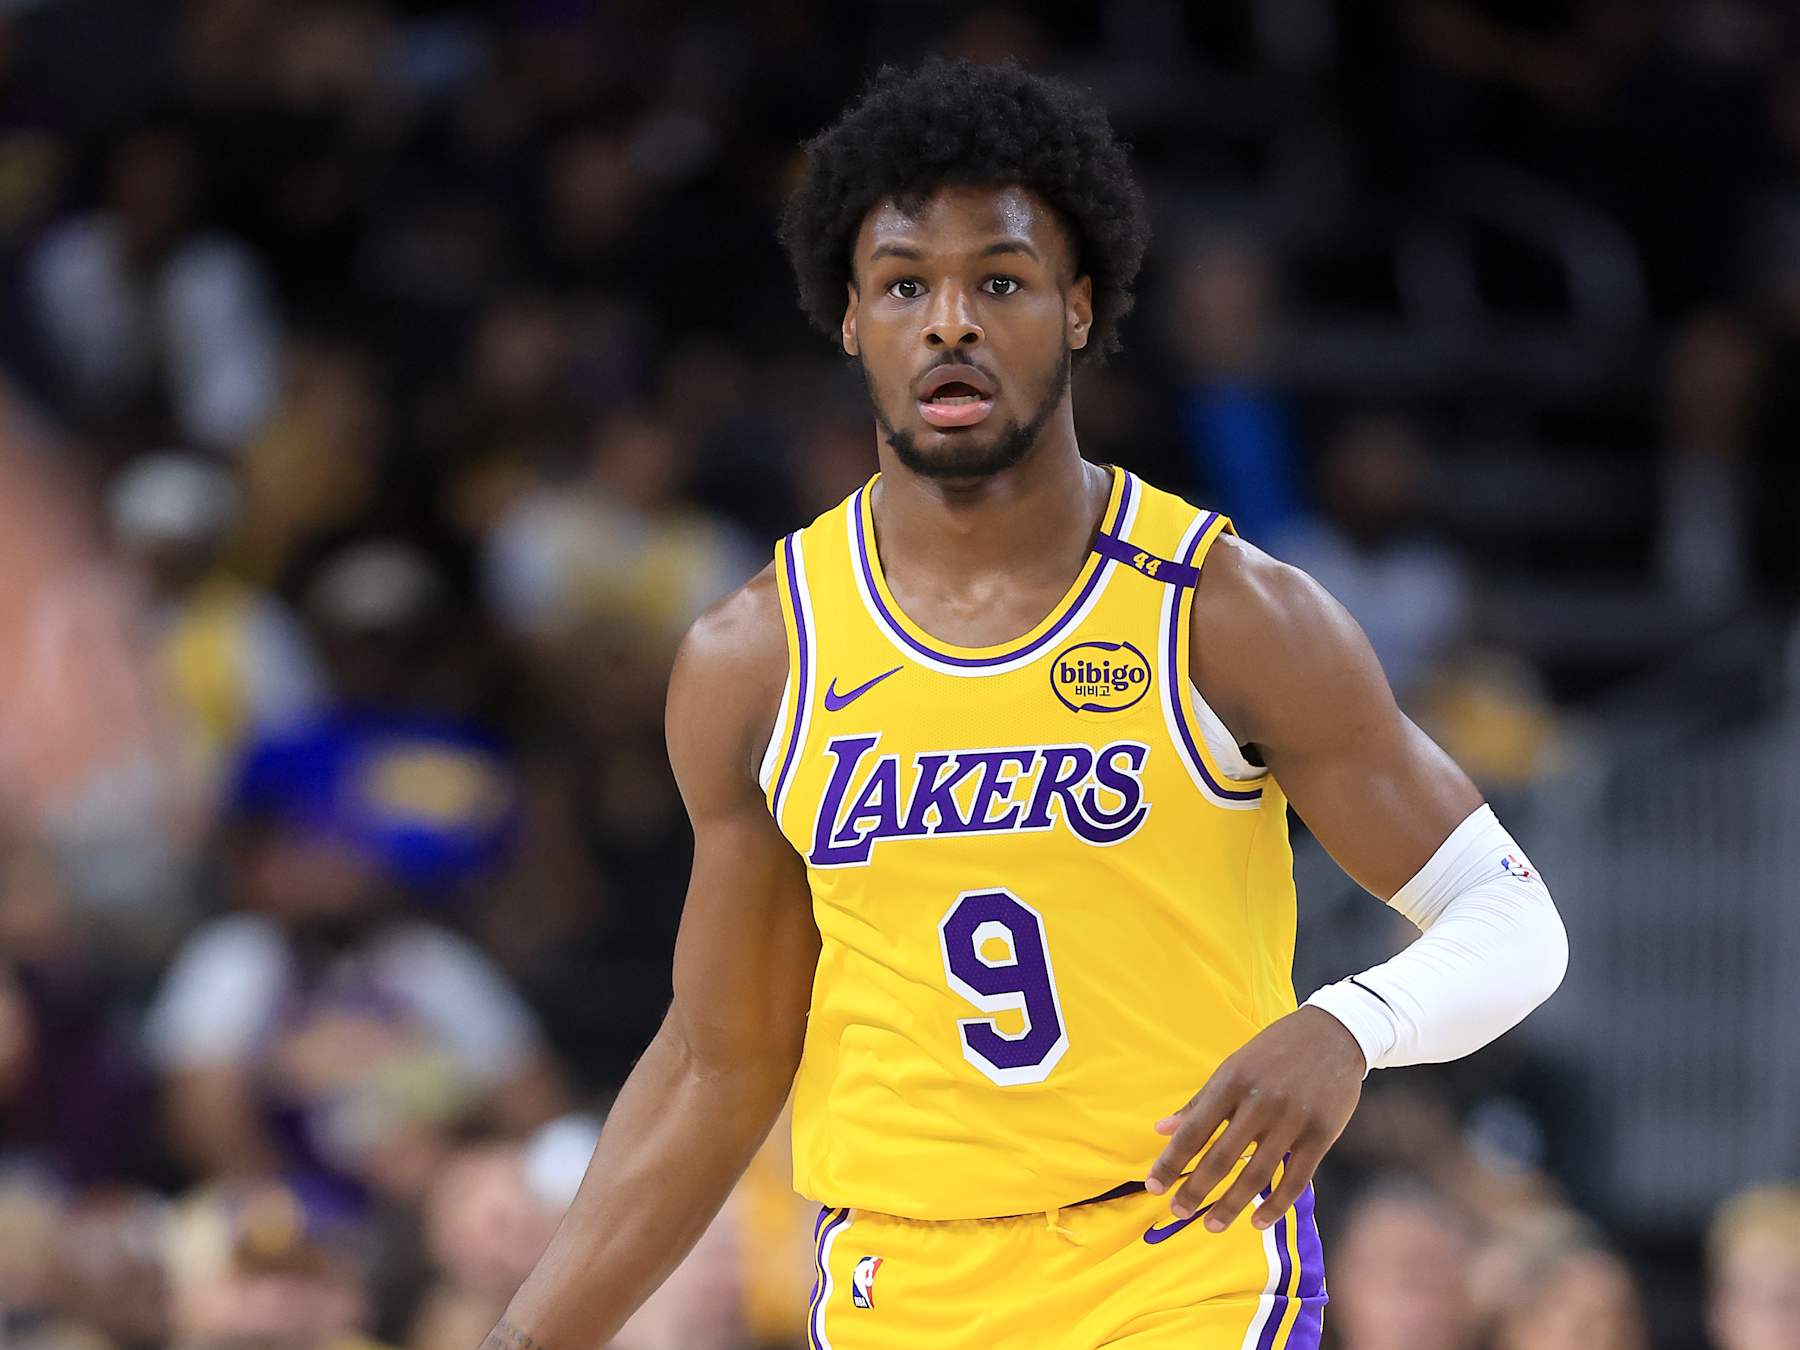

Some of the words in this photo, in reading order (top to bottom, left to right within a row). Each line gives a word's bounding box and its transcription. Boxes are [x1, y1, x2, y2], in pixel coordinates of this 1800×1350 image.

[1133, 552, 1161, 576] 44
[1060, 660, 1145, 691] bibigo
[1075, 685, 1111, 697] 비비고
[807, 733, 1151, 868] LAKERS
[938, 887, 1069, 1085] 9
